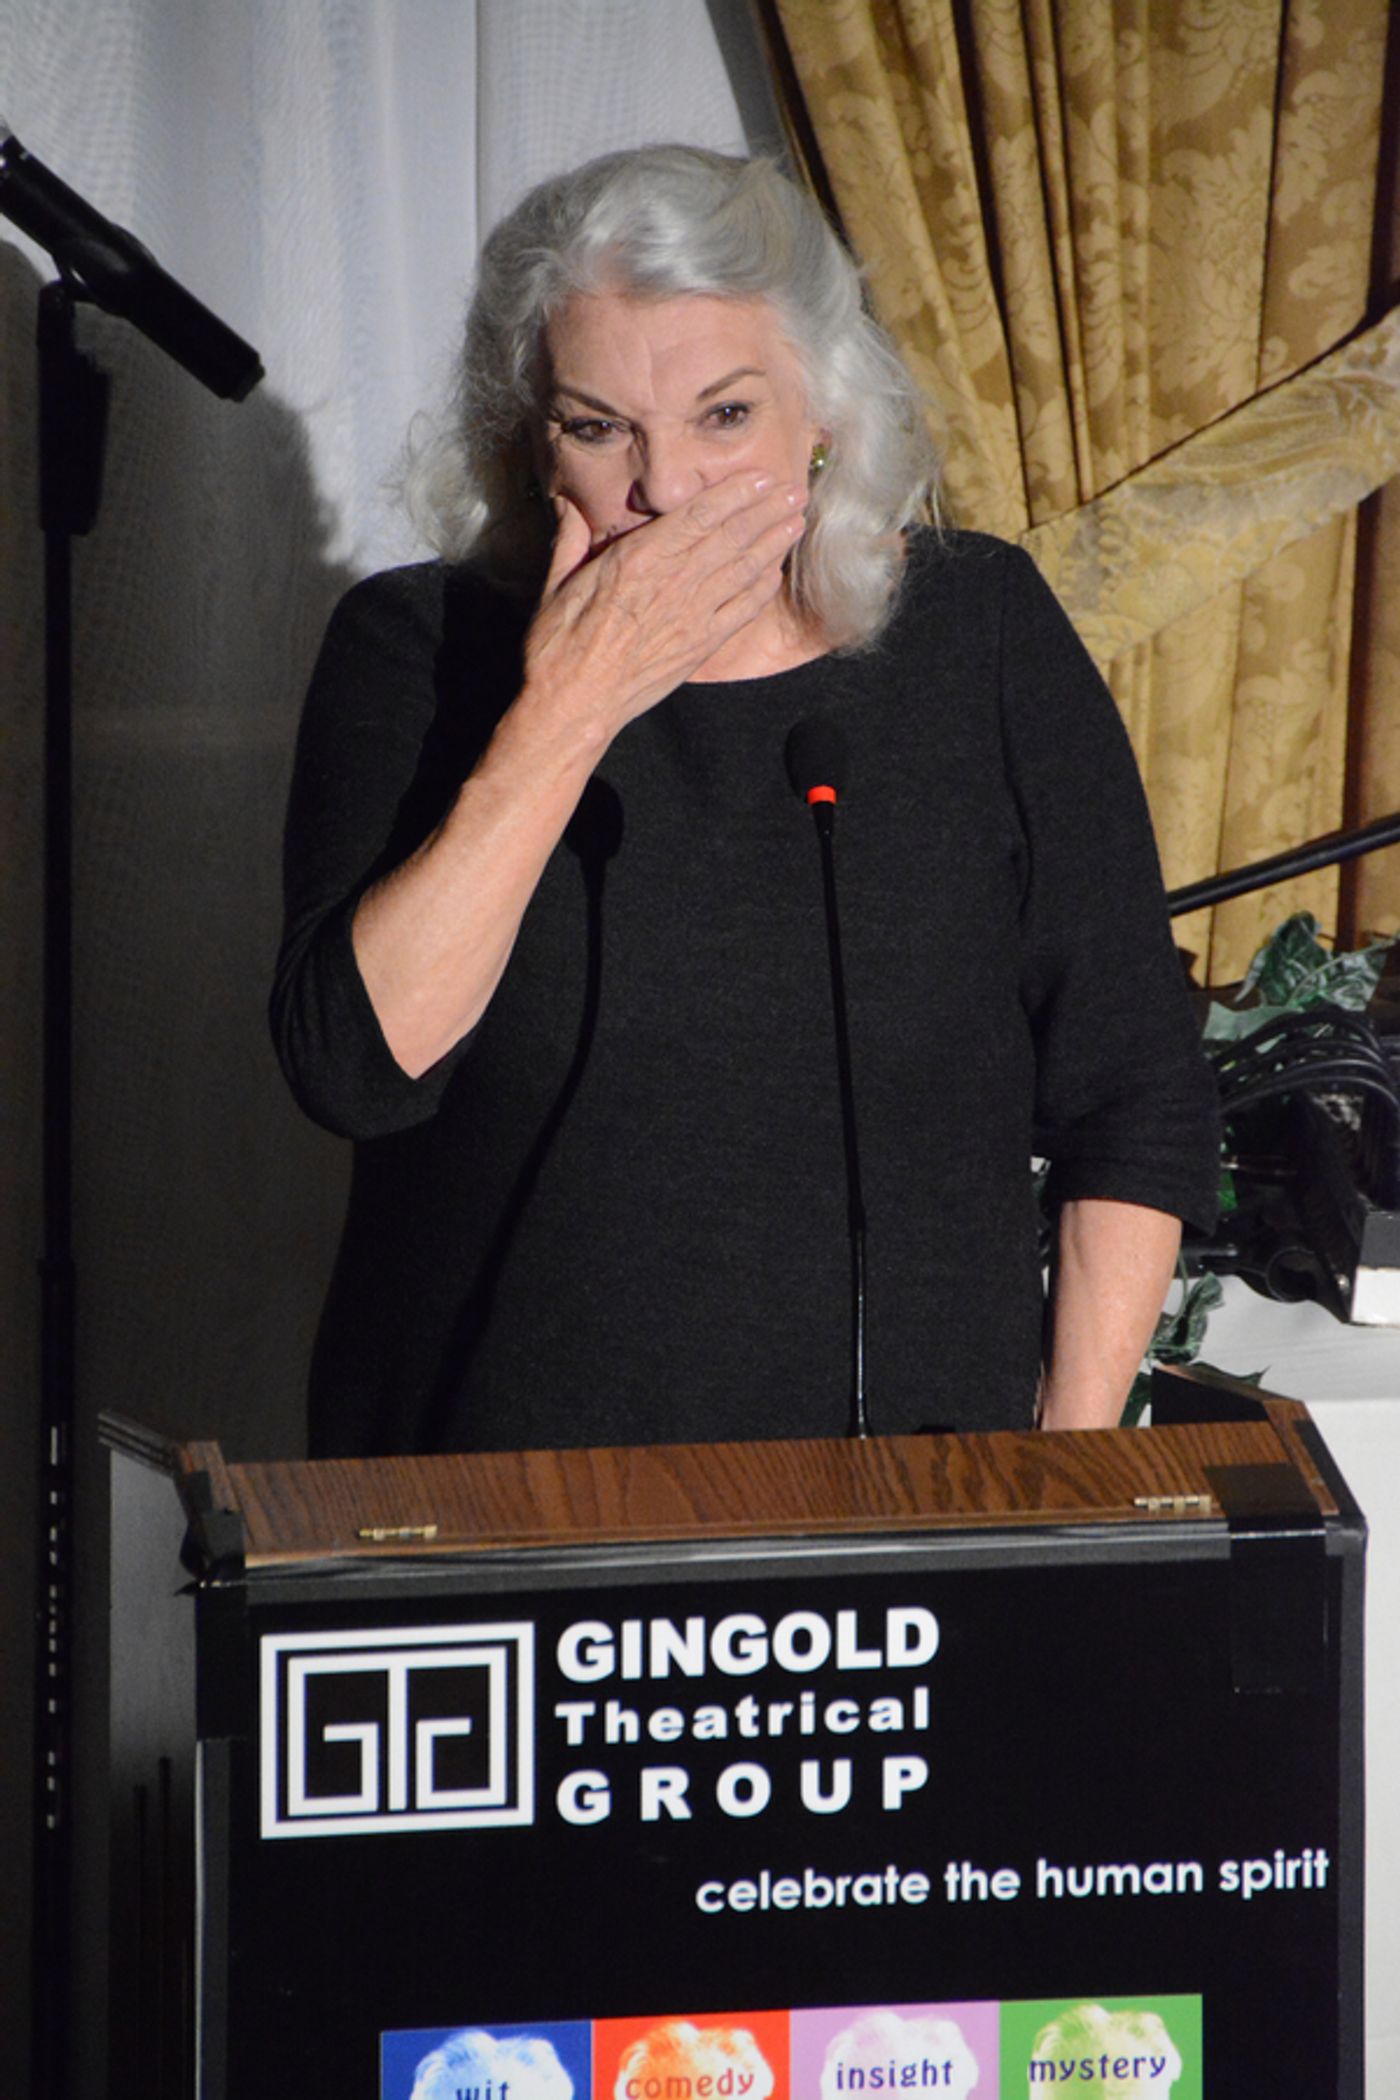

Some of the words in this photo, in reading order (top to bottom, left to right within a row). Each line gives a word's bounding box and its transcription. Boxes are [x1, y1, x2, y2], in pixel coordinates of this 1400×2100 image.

[556, 1607, 940, 1683] GINGOLD
[554, 1686, 930, 1746] Theatrical
[556, 1755, 929, 1825] GROUP
[695, 1864, 930, 1913] celebrate
[943, 1861, 1021, 1902] the
[1036, 1858, 1203, 1898] human
[1219, 1848, 1330, 1900] spirit
[455, 2079, 511, 2100] wit
[624, 2067, 755, 2099] comedy
[835, 2058, 954, 2090] insight
[1028, 2053, 1167, 2082] mystery
